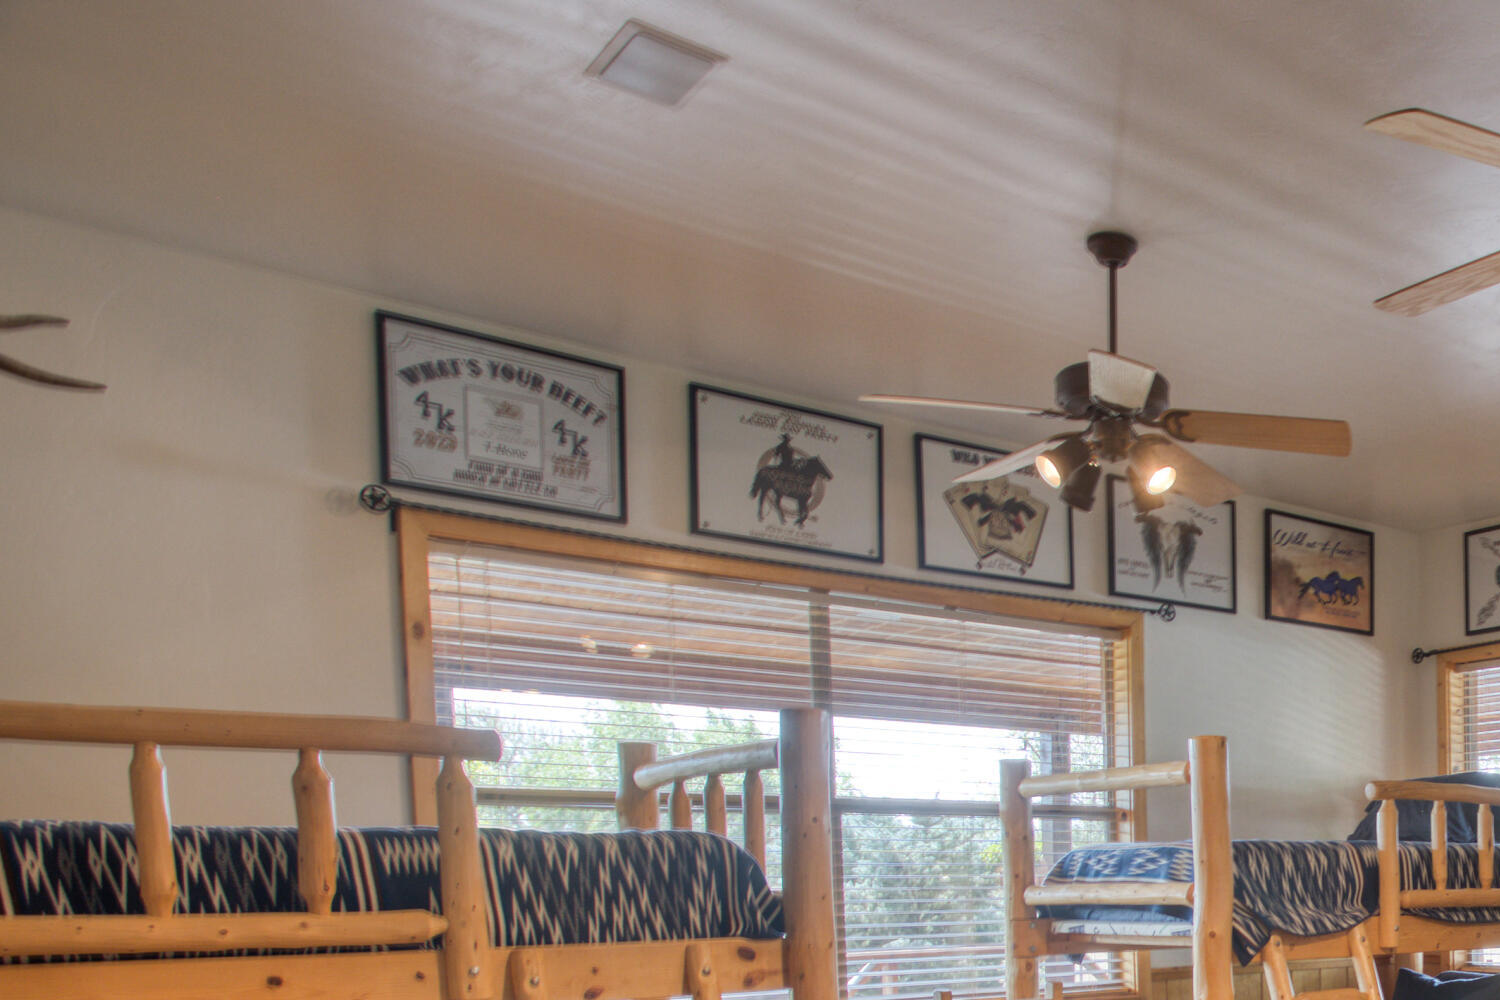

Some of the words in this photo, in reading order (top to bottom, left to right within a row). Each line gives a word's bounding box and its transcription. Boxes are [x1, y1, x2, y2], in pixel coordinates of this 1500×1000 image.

[398, 358, 483, 387] WHAT'S
[487, 360, 546, 394] YOUR
[547, 379, 608, 425] BEEF?
